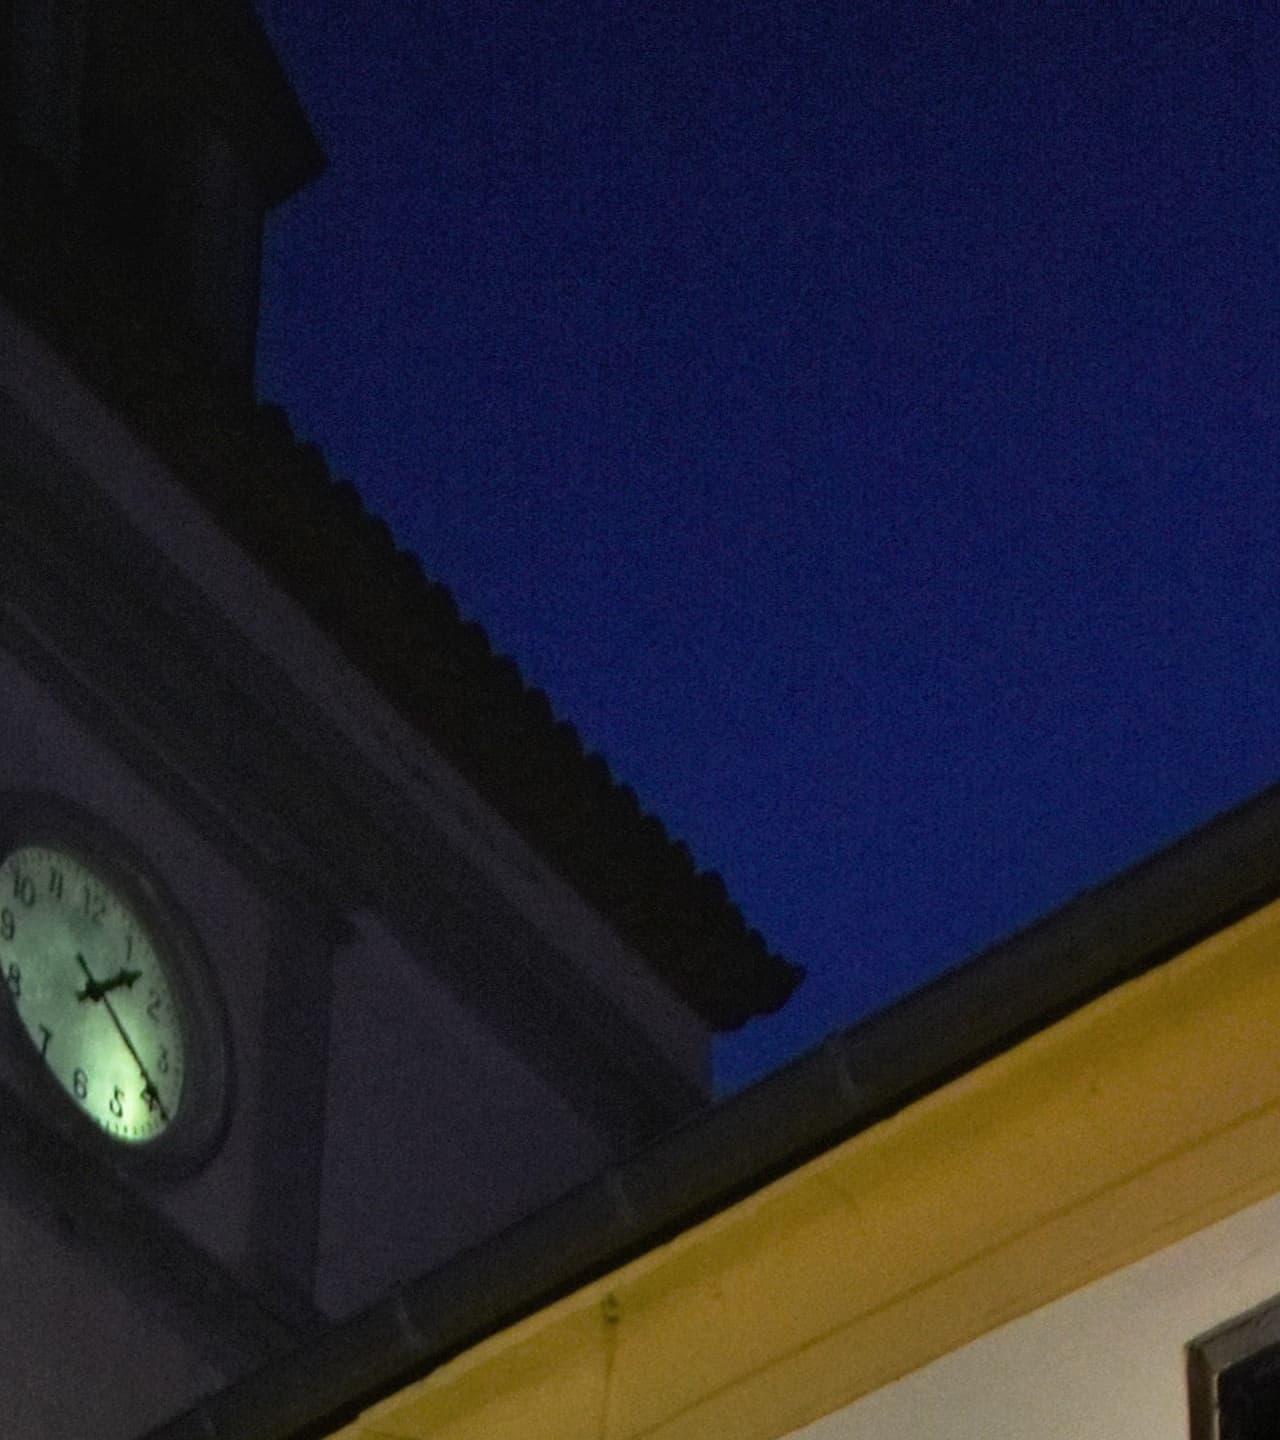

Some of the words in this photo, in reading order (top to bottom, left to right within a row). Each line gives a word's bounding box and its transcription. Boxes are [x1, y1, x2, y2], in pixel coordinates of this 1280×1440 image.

[13, 868, 36, 907] 10
[49, 867, 64, 902] 11
[83, 886, 107, 925] 12
[1, 909, 15, 941] 9
[38, 1024, 53, 1062] 7
[73, 1067, 88, 1099] 6
[109, 1084, 125, 1118] 5
